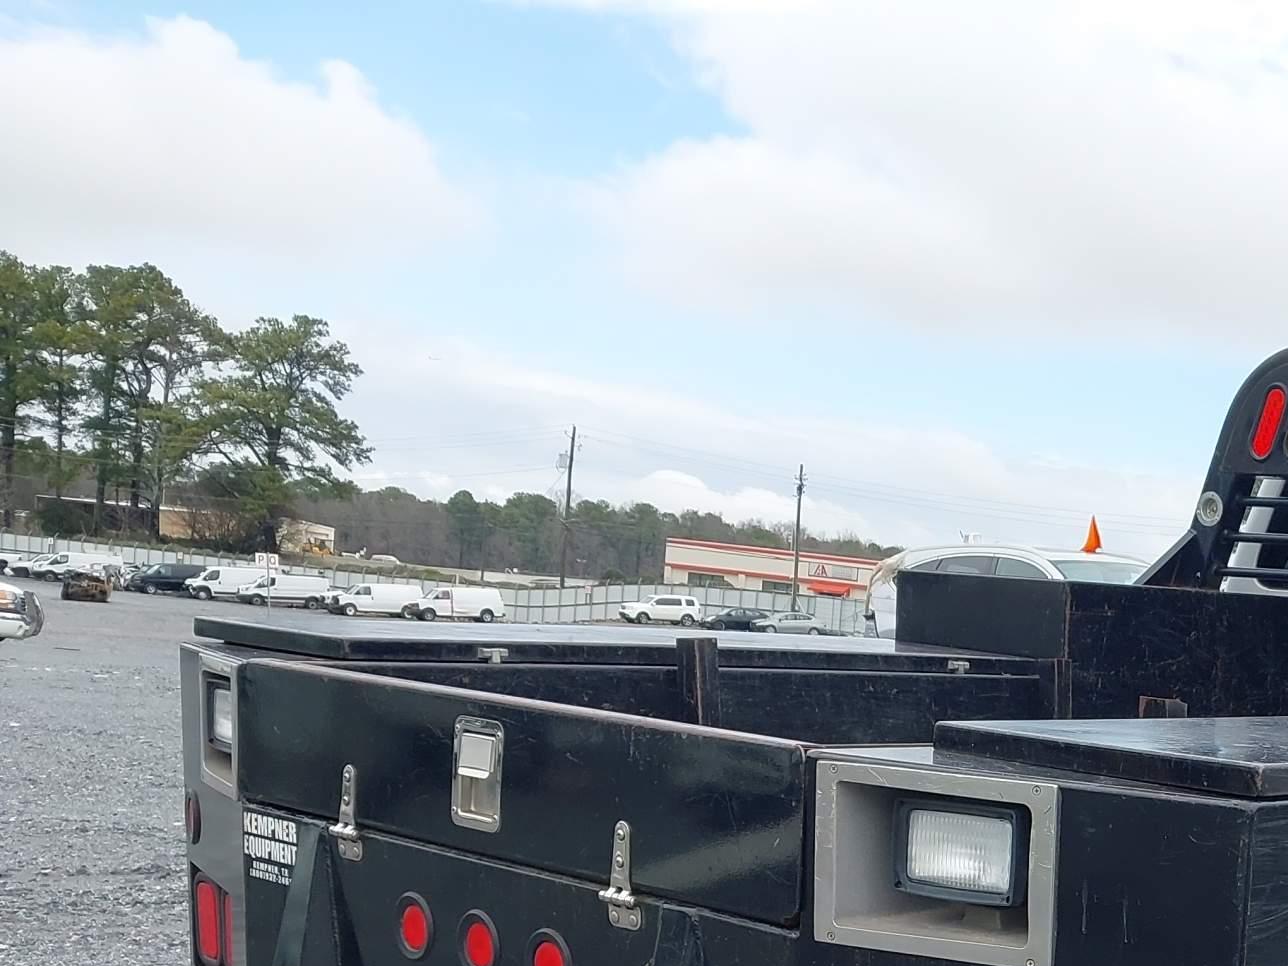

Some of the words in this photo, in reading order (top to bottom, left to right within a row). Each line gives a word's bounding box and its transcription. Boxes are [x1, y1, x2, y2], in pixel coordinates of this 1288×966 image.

[258, 554, 265, 564] P
[243, 811, 297, 844] KEMPNER
[243, 834, 298, 866] EQUIPMENT
